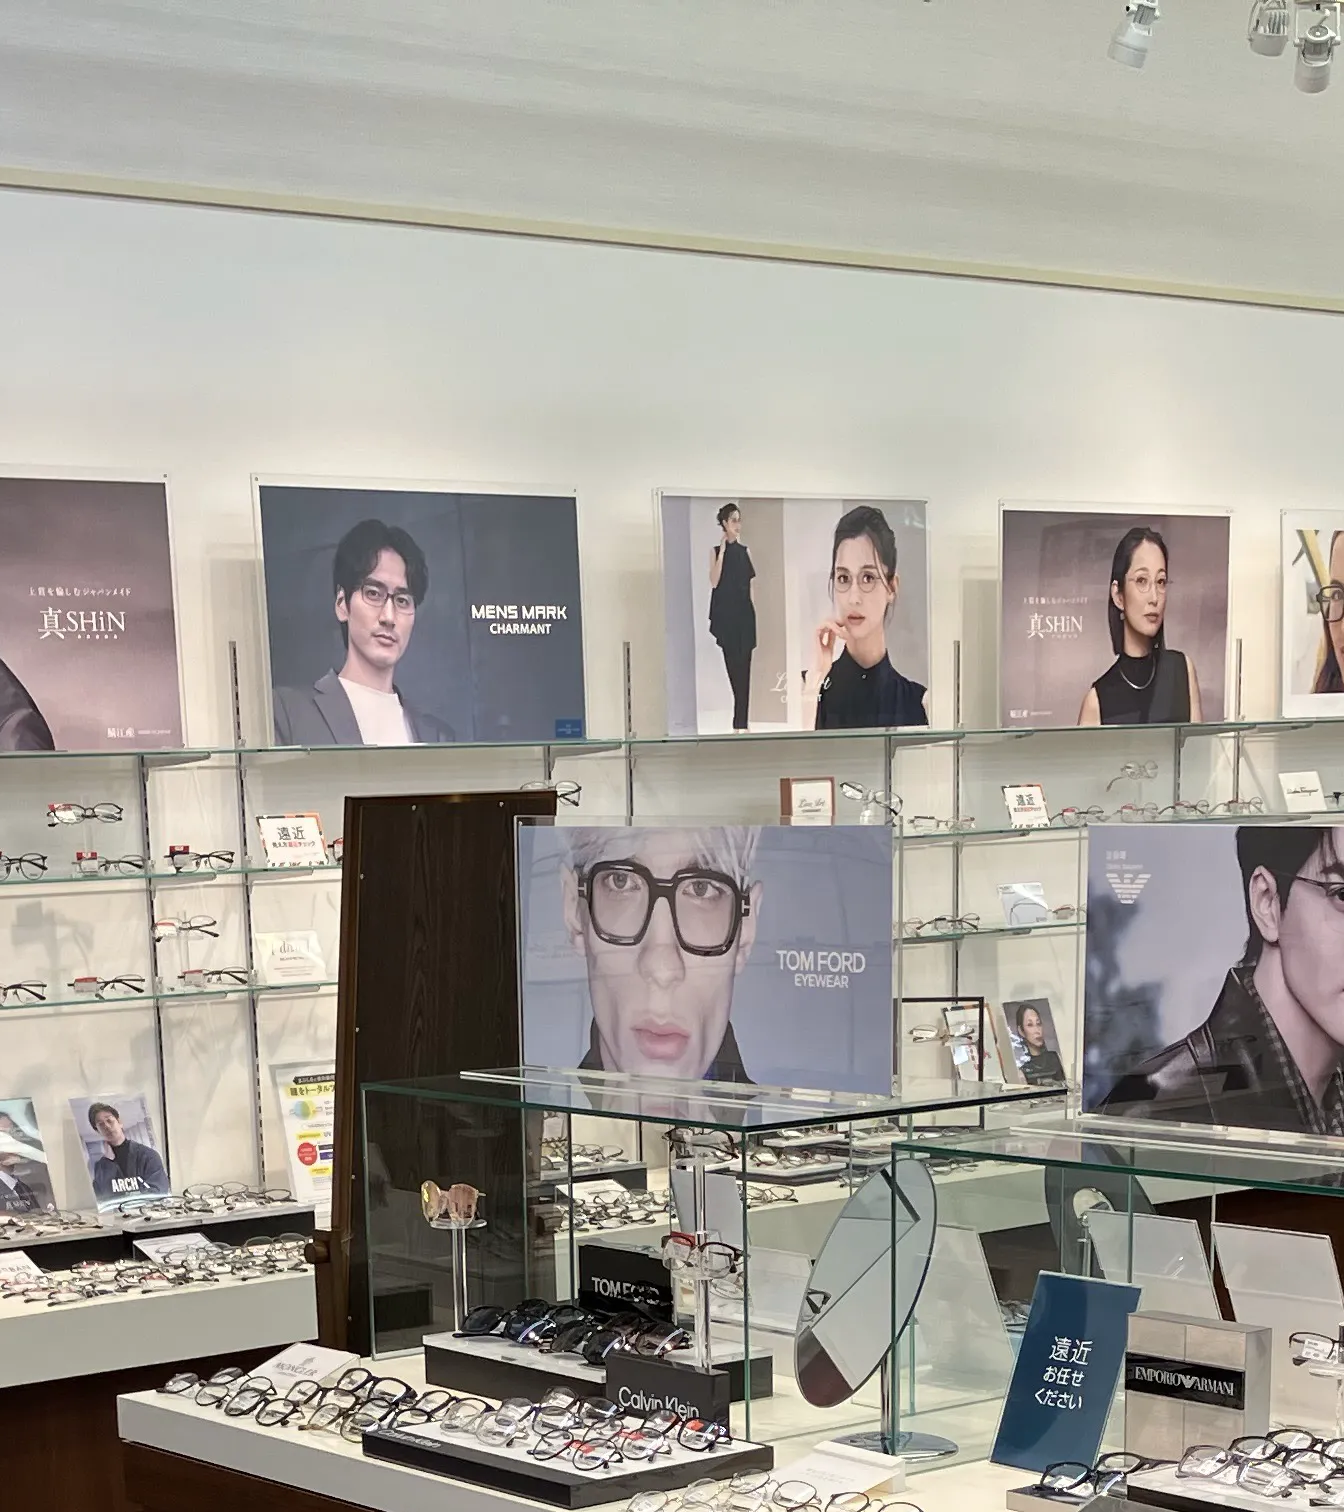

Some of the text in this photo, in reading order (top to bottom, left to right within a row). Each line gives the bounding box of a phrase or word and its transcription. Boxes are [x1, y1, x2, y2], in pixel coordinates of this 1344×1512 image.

[471, 604, 567, 621] MENS MARK
[489, 622, 551, 635] CHARMANT
[277, 826, 306, 841] 遠近
[776, 949, 866, 975] TOM FORD
[794, 974, 849, 989] EYEWEAR
[591, 1276, 621, 1298] TOM
[1049, 1336, 1093, 1366] 遠近
[1043, 1366, 1084, 1387] お任せ
[1135, 1366, 1234, 1396] EMPORIO ARMANI
[618, 1386, 700, 1421] Calvin Klein
[1034, 1387, 1082, 1410] ください
